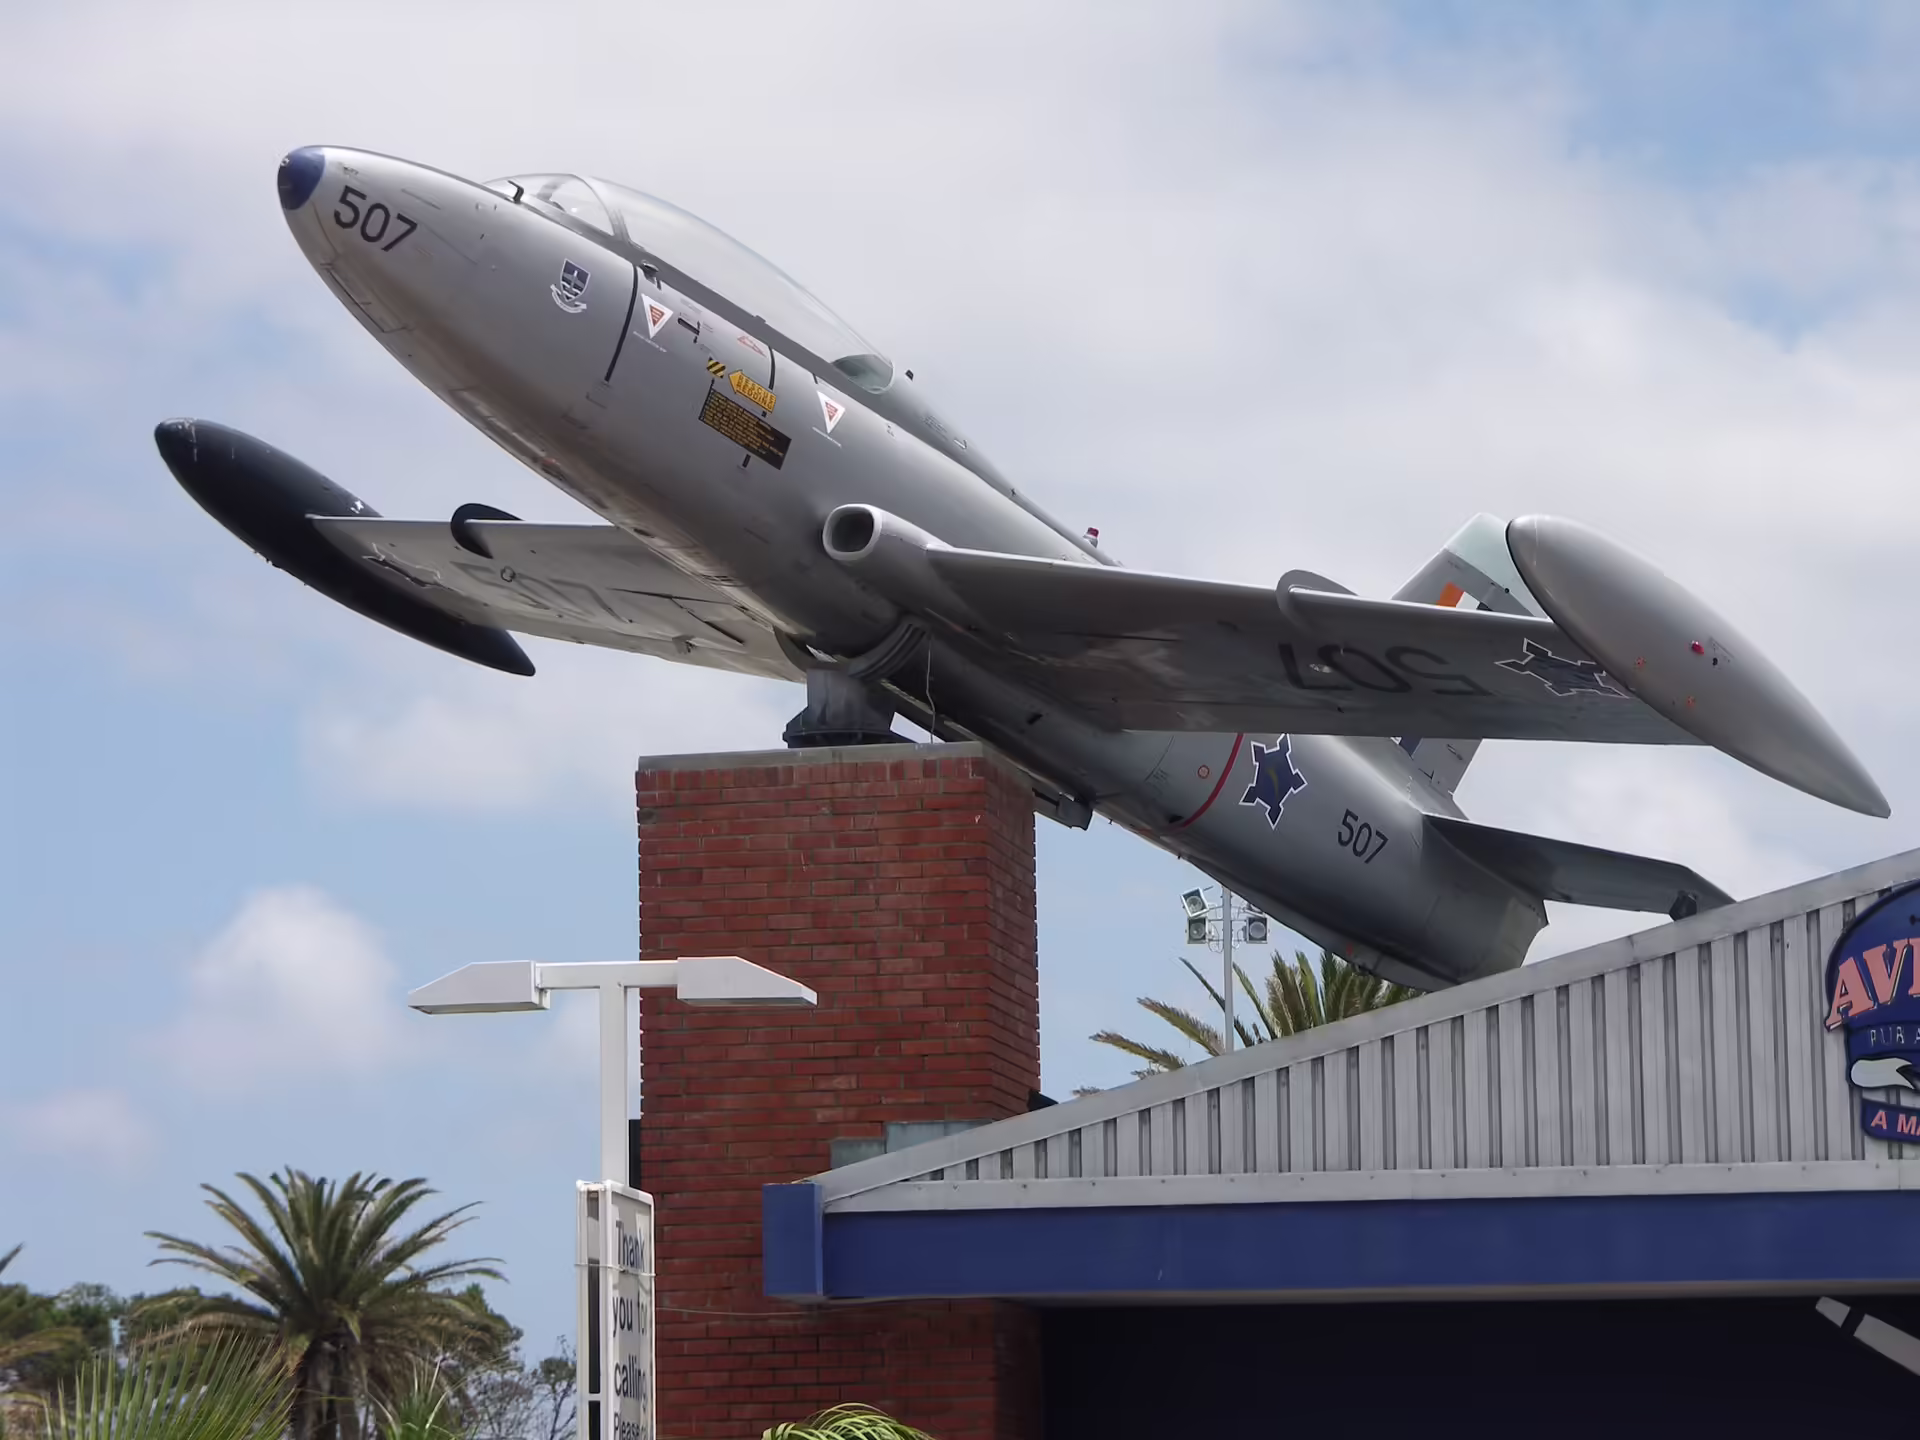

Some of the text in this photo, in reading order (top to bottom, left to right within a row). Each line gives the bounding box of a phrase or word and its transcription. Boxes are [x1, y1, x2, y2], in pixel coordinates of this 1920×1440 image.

[334, 185, 417, 252] 507
[1279, 643, 1495, 696] 507
[1337, 808, 1389, 864] 507
[1871, 1110, 1920, 1136] A M
[613, 1296, 633, 1337] you
